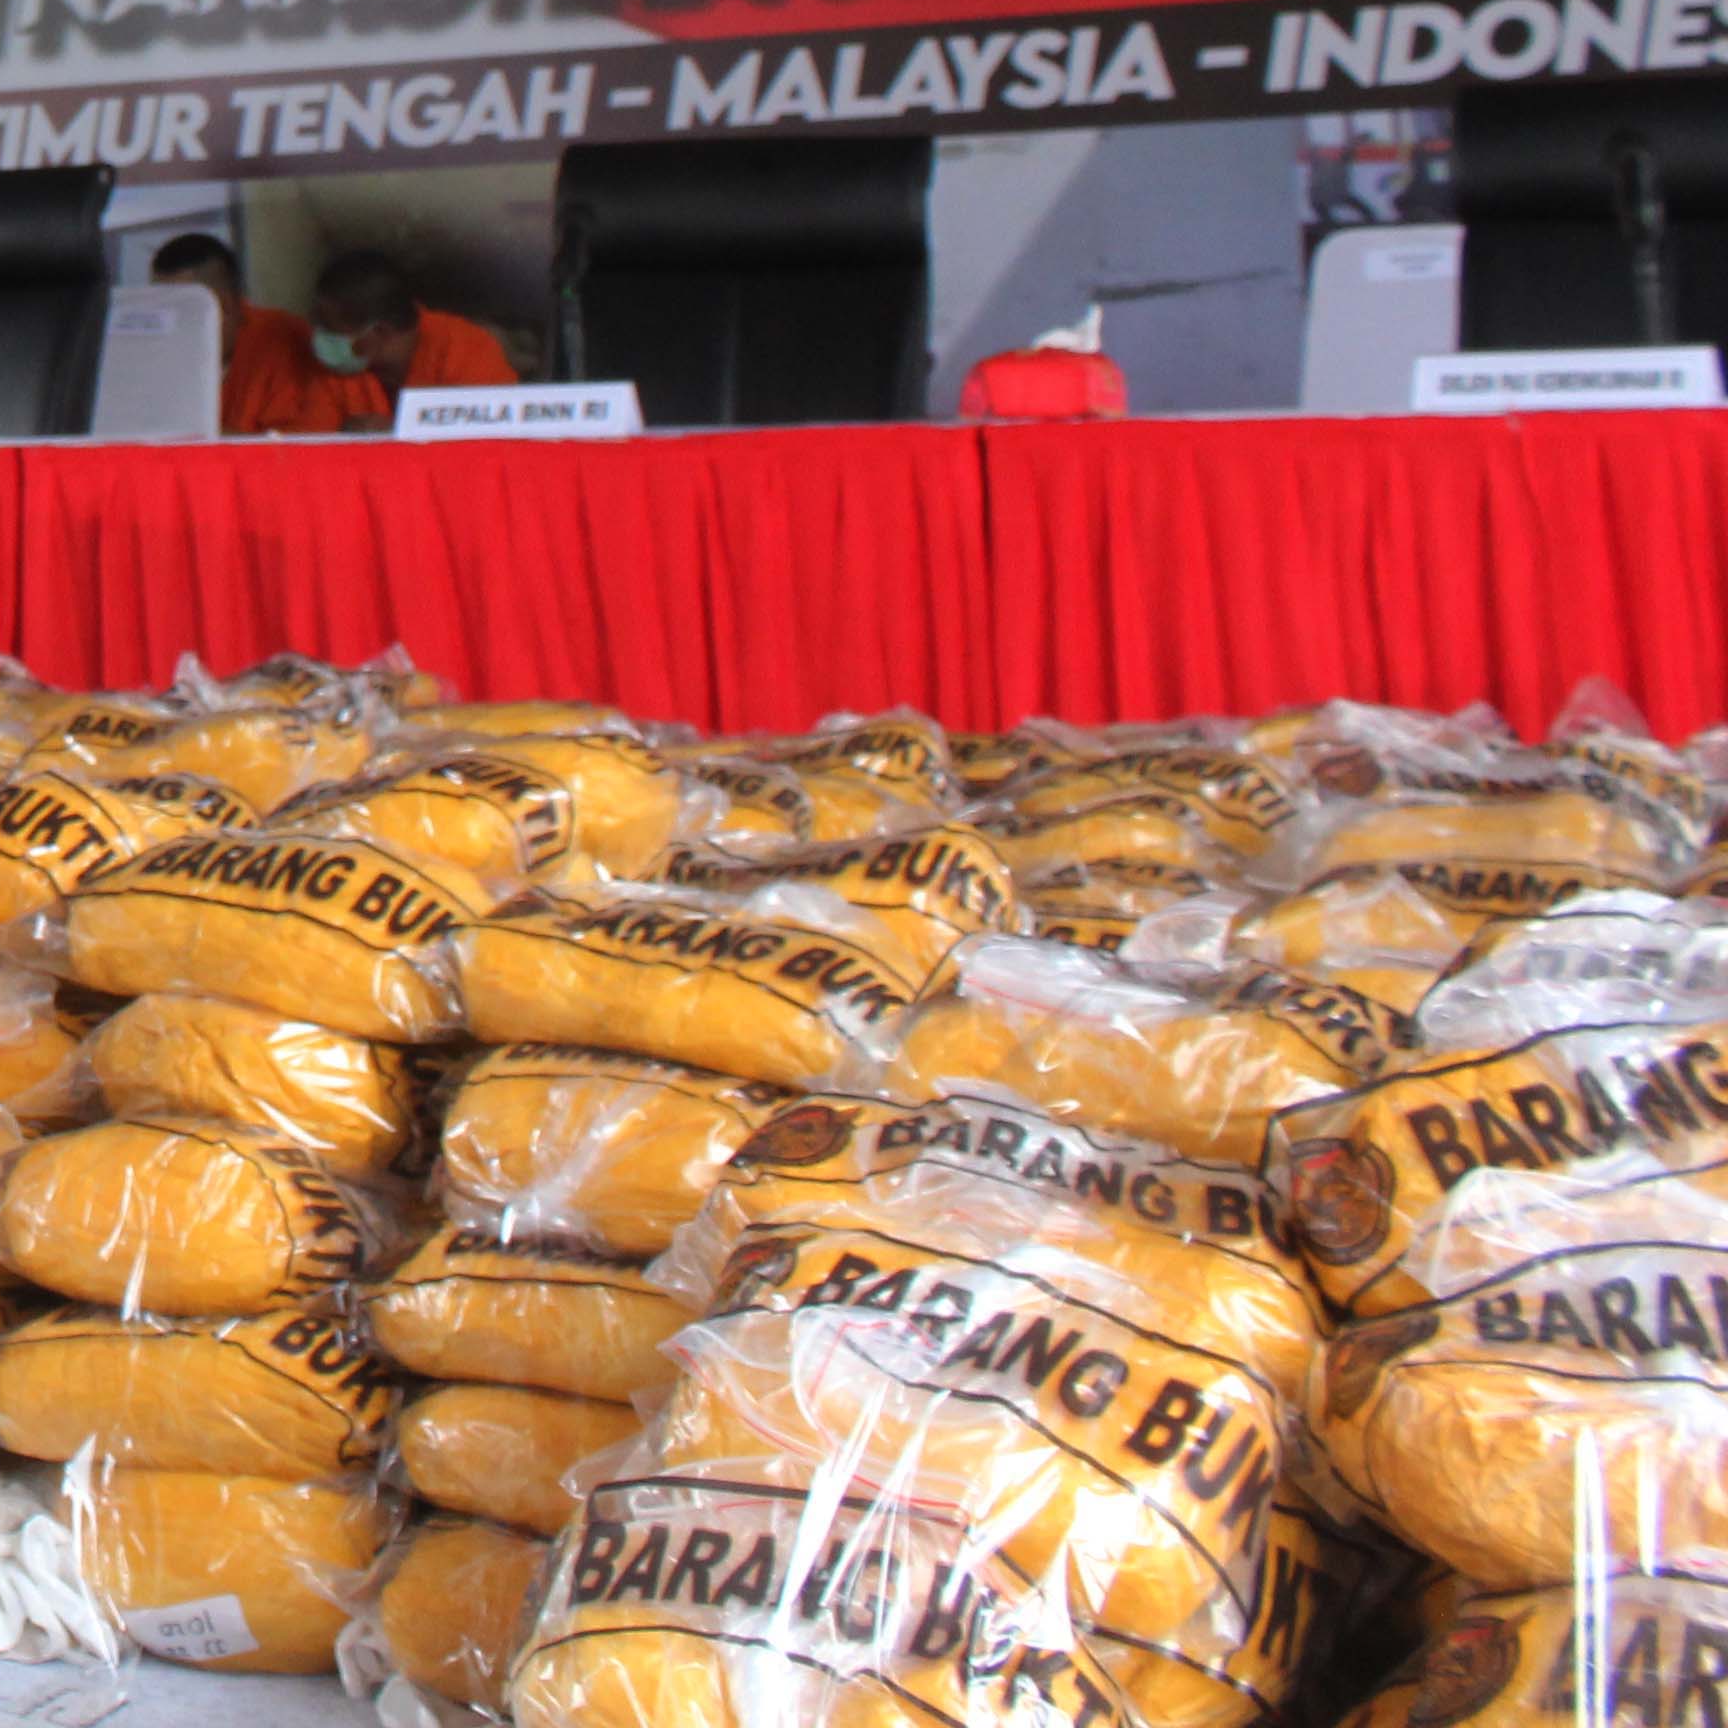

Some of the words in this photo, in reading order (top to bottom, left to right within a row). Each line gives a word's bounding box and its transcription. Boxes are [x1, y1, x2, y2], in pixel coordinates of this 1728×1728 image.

[231, 63, 595, 159] TENGAH
[666, 22, 1176, 130] MALAYSIA
[417, 403, 513, 425] KEPALA
[520, 402, 575, 423] BNN
[581, 400, 610, 421] RI
[141, 840, 357, 901] BARANG
[876, 1118, 1178, 1226] BARANG
[800, 1253, 1129, 1420] BARANG
[1475, 1273, 1728, 1361] BARA
[568, 1521, 901, 1645] BARANG
